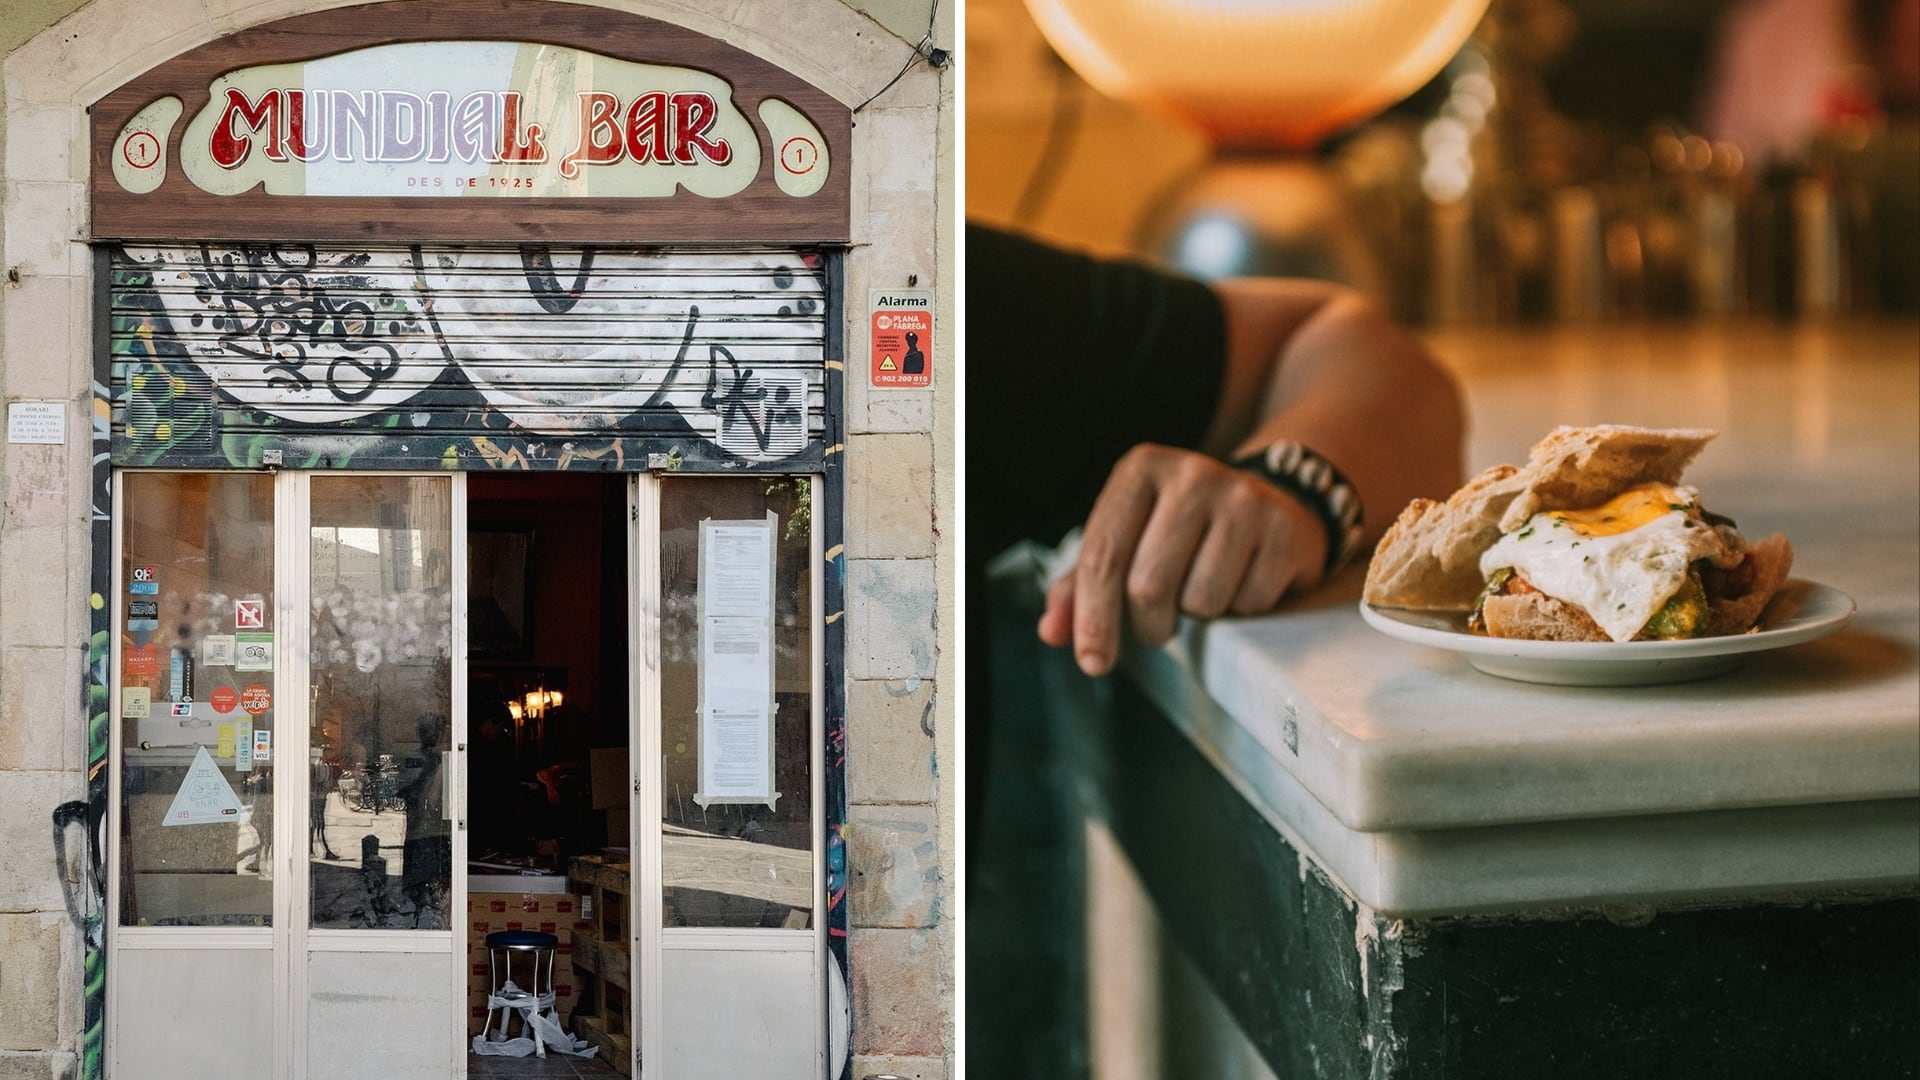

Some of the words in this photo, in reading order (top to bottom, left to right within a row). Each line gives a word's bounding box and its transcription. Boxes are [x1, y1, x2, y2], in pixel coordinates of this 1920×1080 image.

[211, 88, 548, 168] MUNDIAL
[560, 88, 733, 178] BAR
[407, 177, 442, 187] DES
[455, 177, 476, 188] DE
[489, 177, 533, 188] 1925
[877, 296, 928, 307] Alarma
